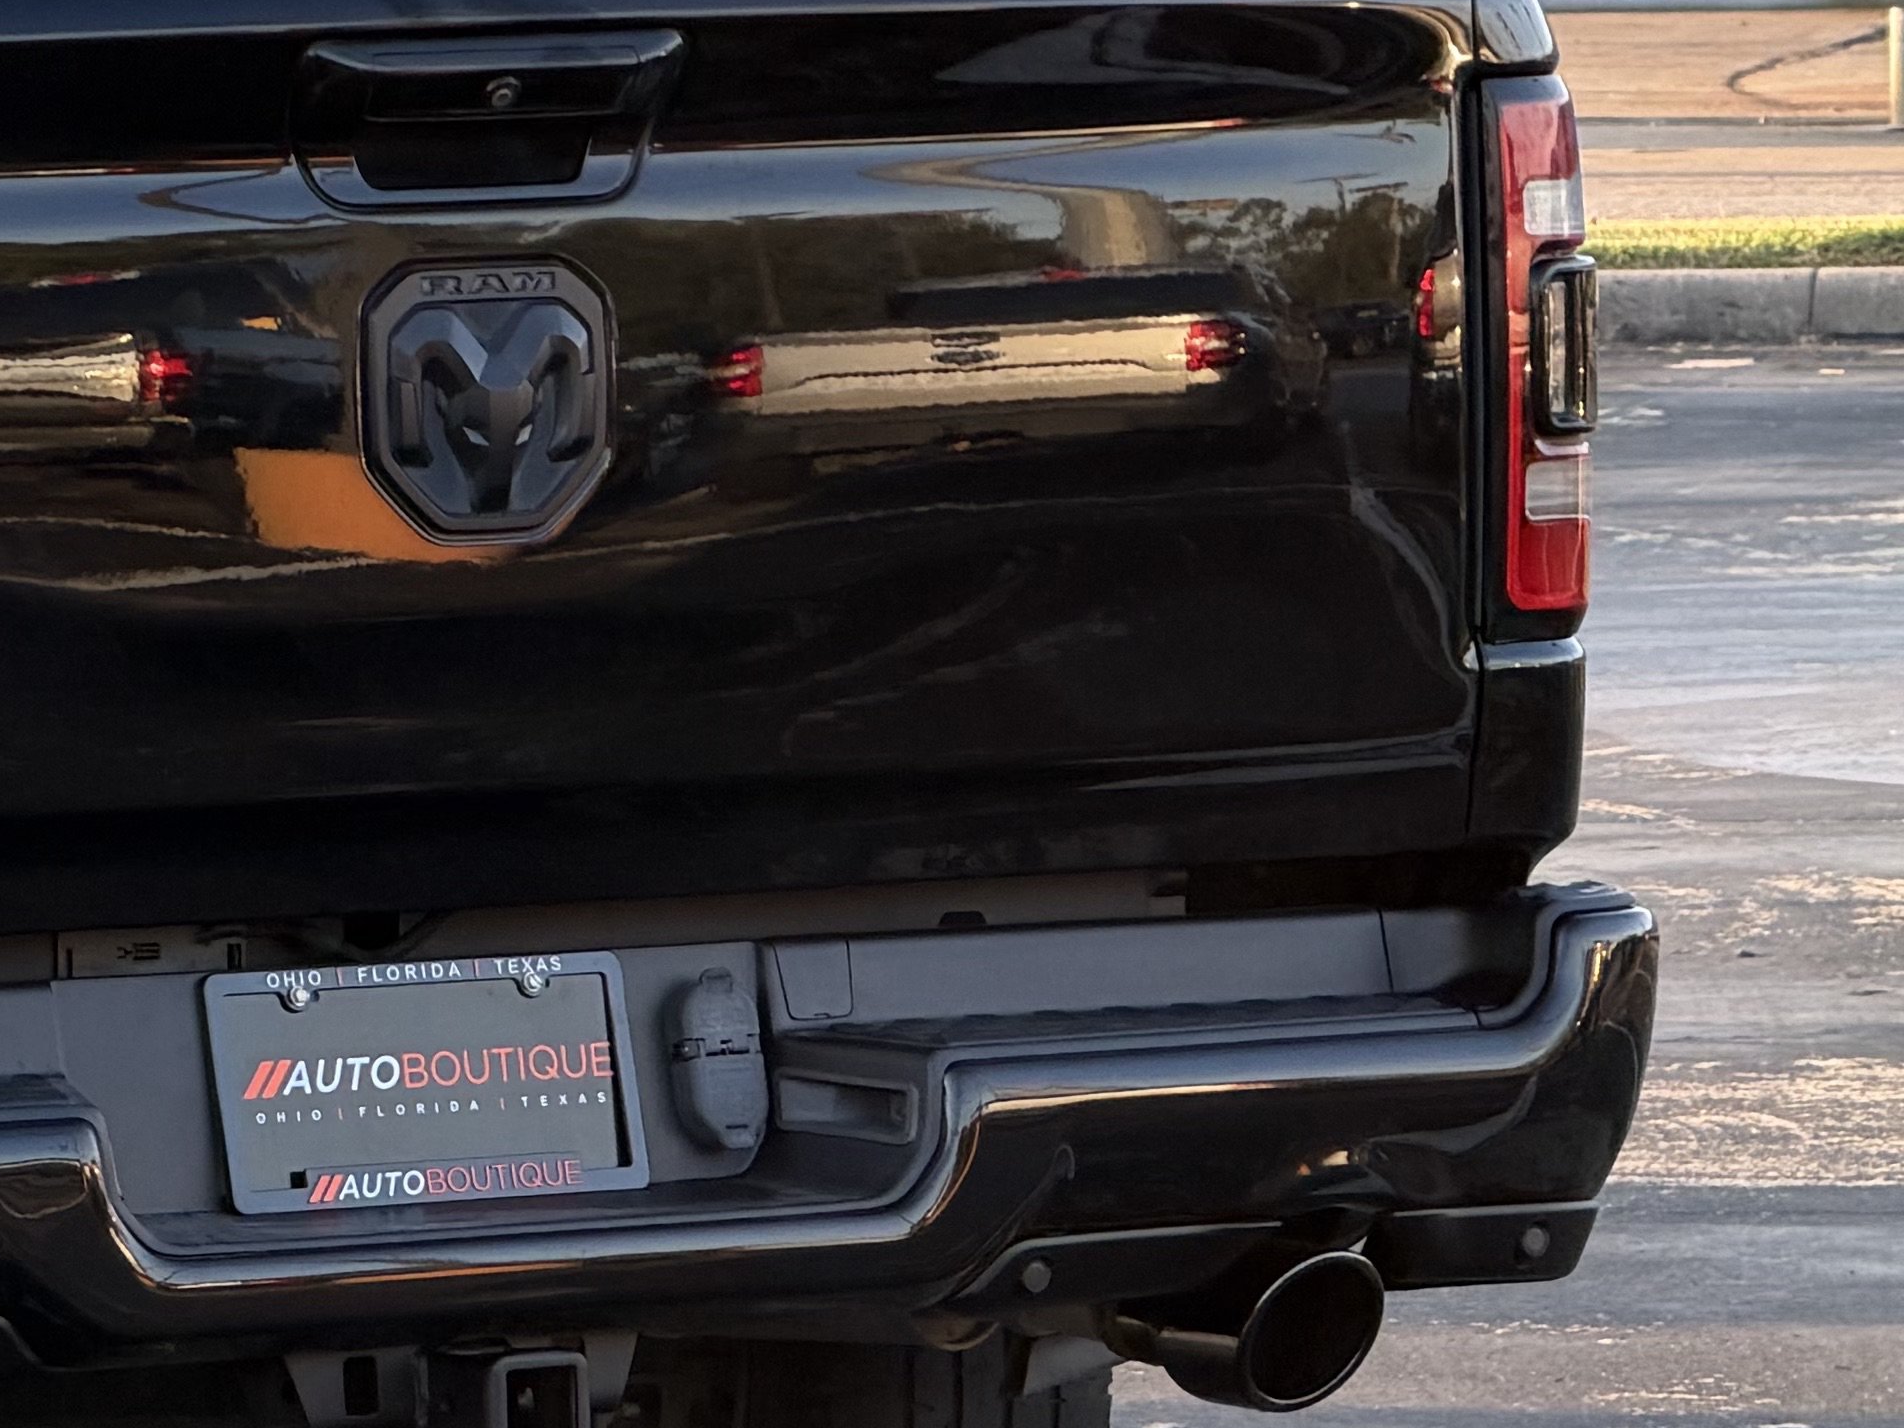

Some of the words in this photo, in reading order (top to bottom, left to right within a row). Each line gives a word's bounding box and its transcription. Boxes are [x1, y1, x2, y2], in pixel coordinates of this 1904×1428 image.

[420, 271, 557, 297] RAM
[265, 969, 323, 989] OHIO
[356, 960, 462, 984] FLORIDA
[493, 955, 563, 976] TEXAS
[255, 1108, 323, 1125] OHIO
[358, 1099, 480, 1119] FLORIDA
[521, 1090, 608, 1109] TEXAS
